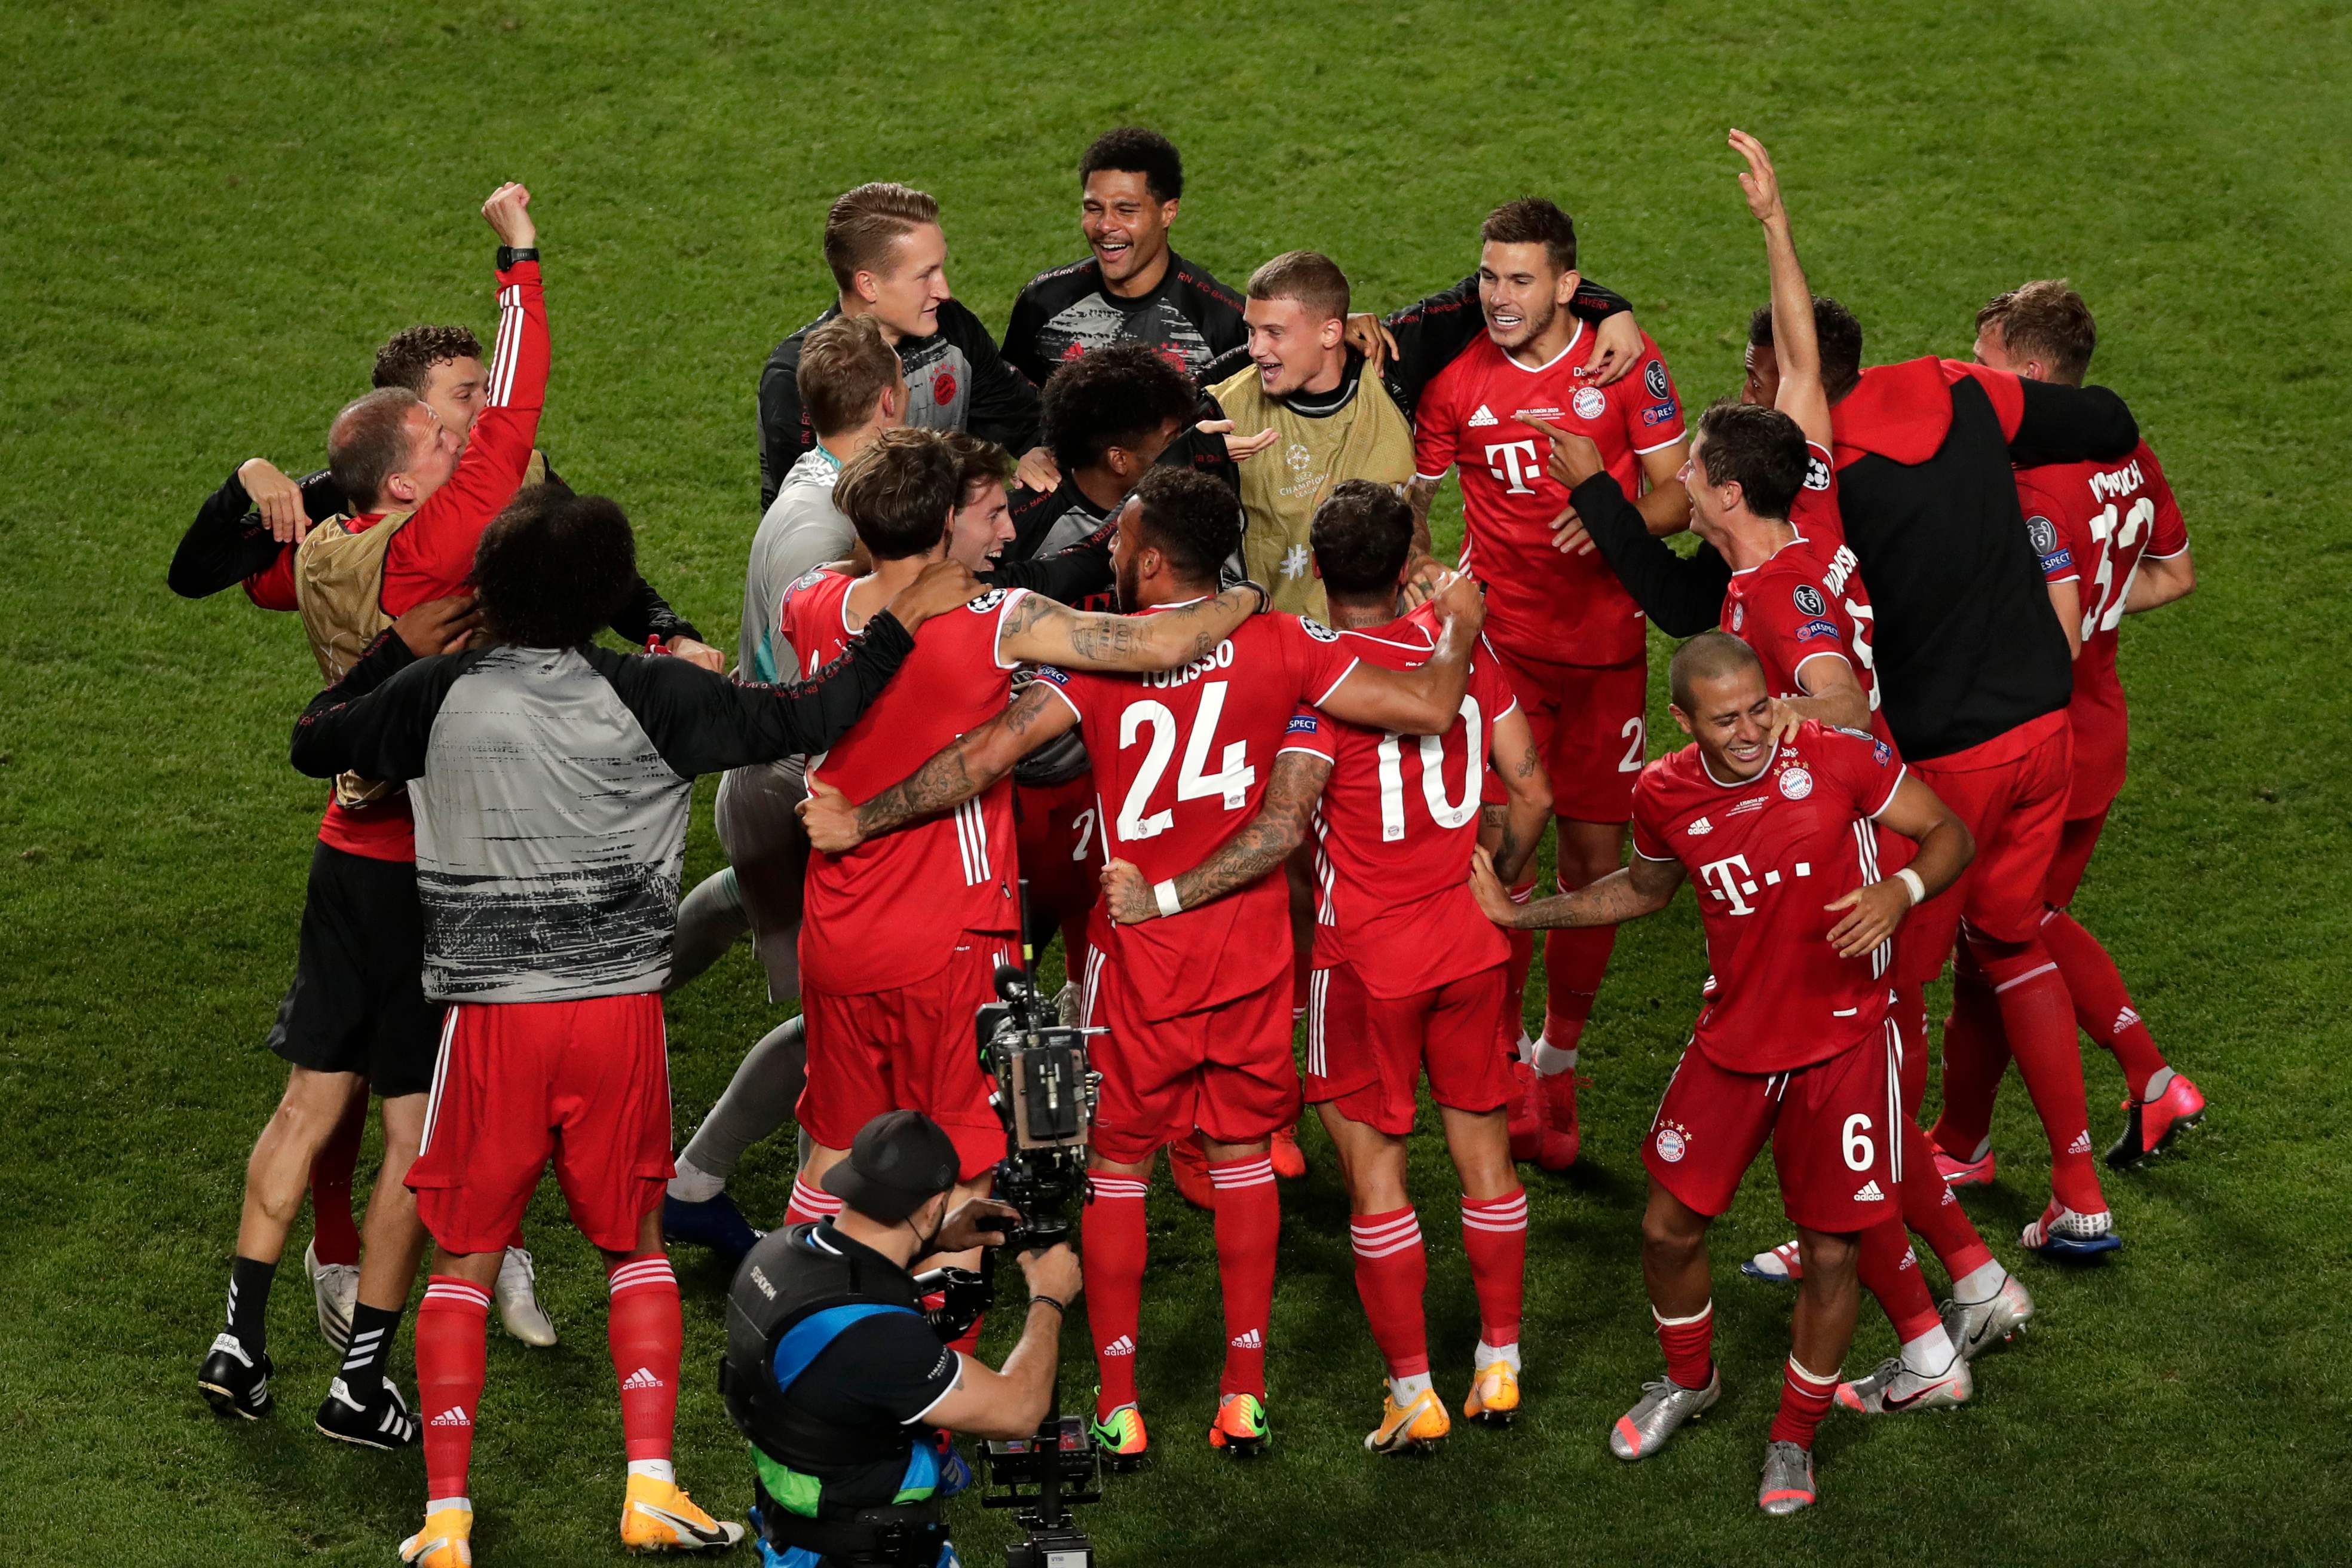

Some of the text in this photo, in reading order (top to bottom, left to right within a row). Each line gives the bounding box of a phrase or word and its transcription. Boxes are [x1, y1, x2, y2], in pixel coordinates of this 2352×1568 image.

[1658, 378, 1665, 389] 5
[1468, 417, 1499, 427] adidas
[2037, 535, 2045, 546] 5
[2040, 552, 2070, 570] ESPECT
[1808, 599, 1817, 608] 5
[1810, 621, 1839, 637] RESPECT
[1043, 667, 1068, 683] SPECT
[1287, 719, 1316, 730] SPECT
[1116, 680, 1255, 843] 24
[1377, 693, 1482, 843] 10
[1842, 1113, 1875, 1172] 6
[1854, 1193, 1885, 1202] adidas
[1231, 1340, 1262, 1349] adidas
[1104, 1345, 1136, 1356] adidas
[622, 1379, 664, 1391] adidas
[430, 1417, 471, 1426] adidas
